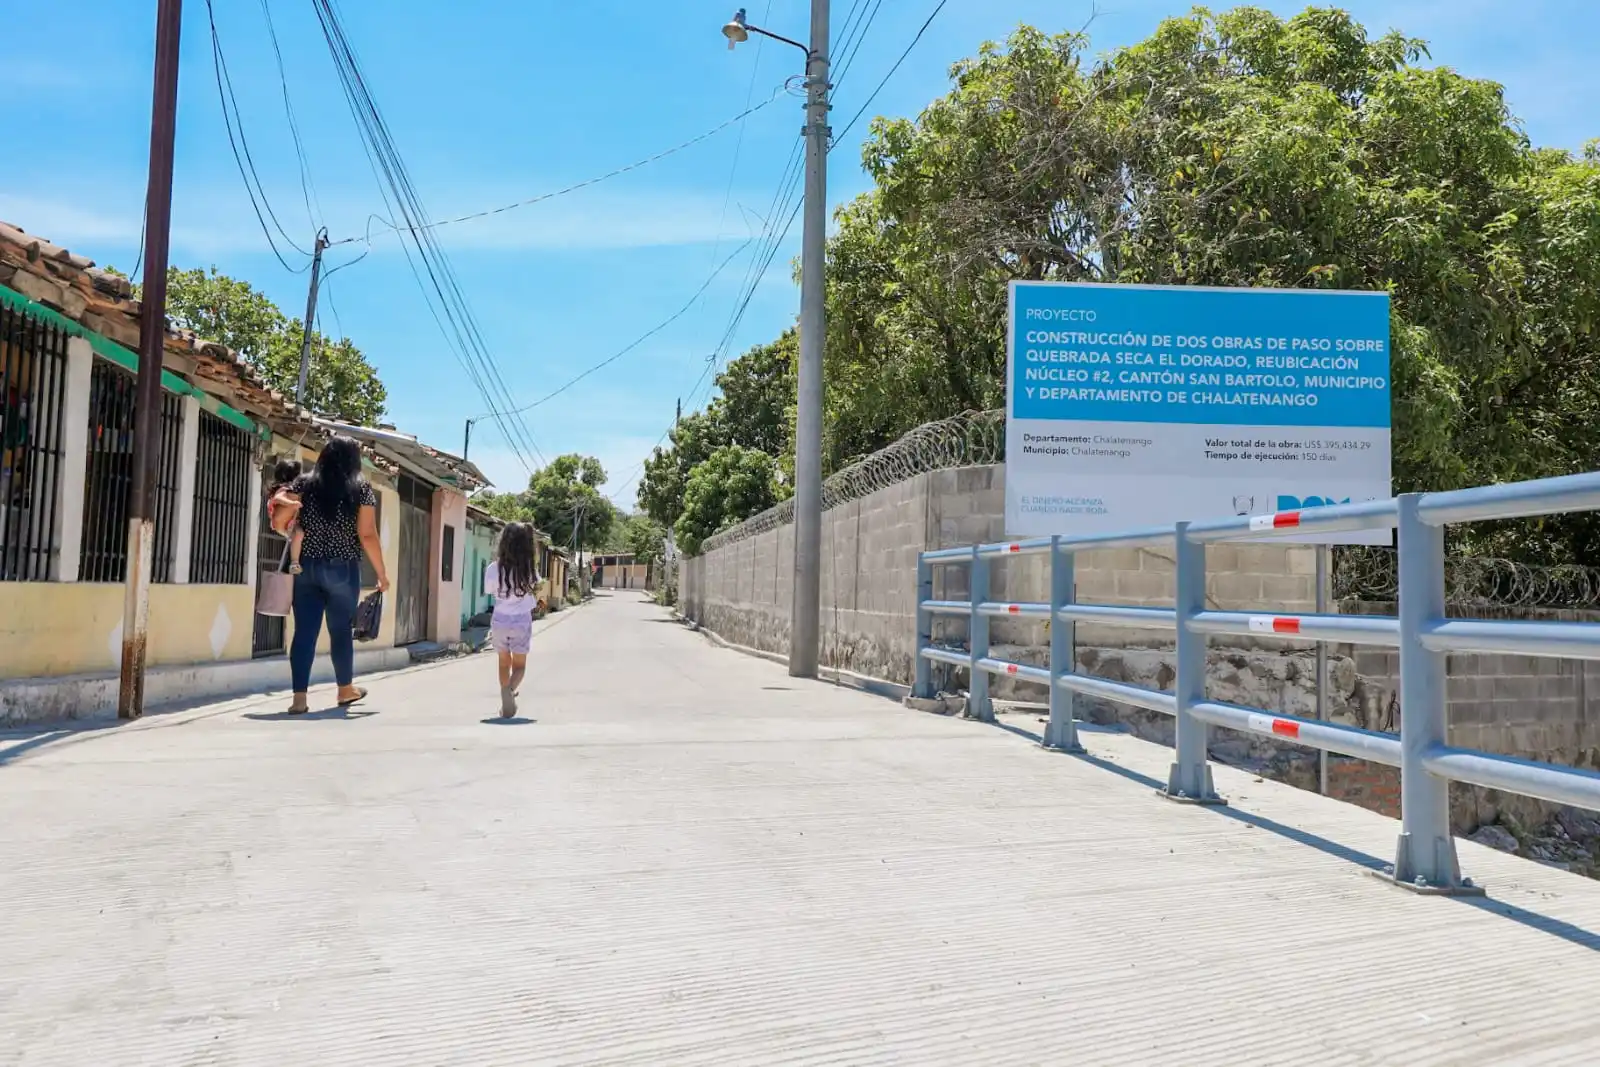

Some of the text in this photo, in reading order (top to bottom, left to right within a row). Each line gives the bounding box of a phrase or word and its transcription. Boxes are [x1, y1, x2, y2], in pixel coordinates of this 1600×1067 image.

[1026, 308, 1097, 322] PROYECTO
[1026, 331, 1384, 352] CONSTRUCCIÓN DE DOS OBRAS DE PASO SOBRE
[1026, 350, 1358, 369] QUEBRADA SECA EL DORADO, REUBICACIÓN
[1026, 366, 1385, 389] NÚCLEO #2, CANTÓN SAN BARTOLO, MUNICIPIO
[1025, 387, 1318, 406] Y DEPARTAMENTO DE CHALATENANGO
[1023, 434, 1153, 447] Departamento: Chalatenango
[1205, 439, 1227, 447] Valor
[1231, 440, 1252, 448] total
[1255, 440, 1266, 448] de
[1268, 440, 1276, 448] la
[1304, 441, 1321, 449] US$
[1023, 446, 1131, 458] Municipio: Chalatenango
[1204, 451, 1238, 460] Tiempo
[1241, 451, 1252, 459] de
[1255, 452, 1299, 462] ejecución:
[1021, 496, 1103, 505] EL DINERO ALCANZA
